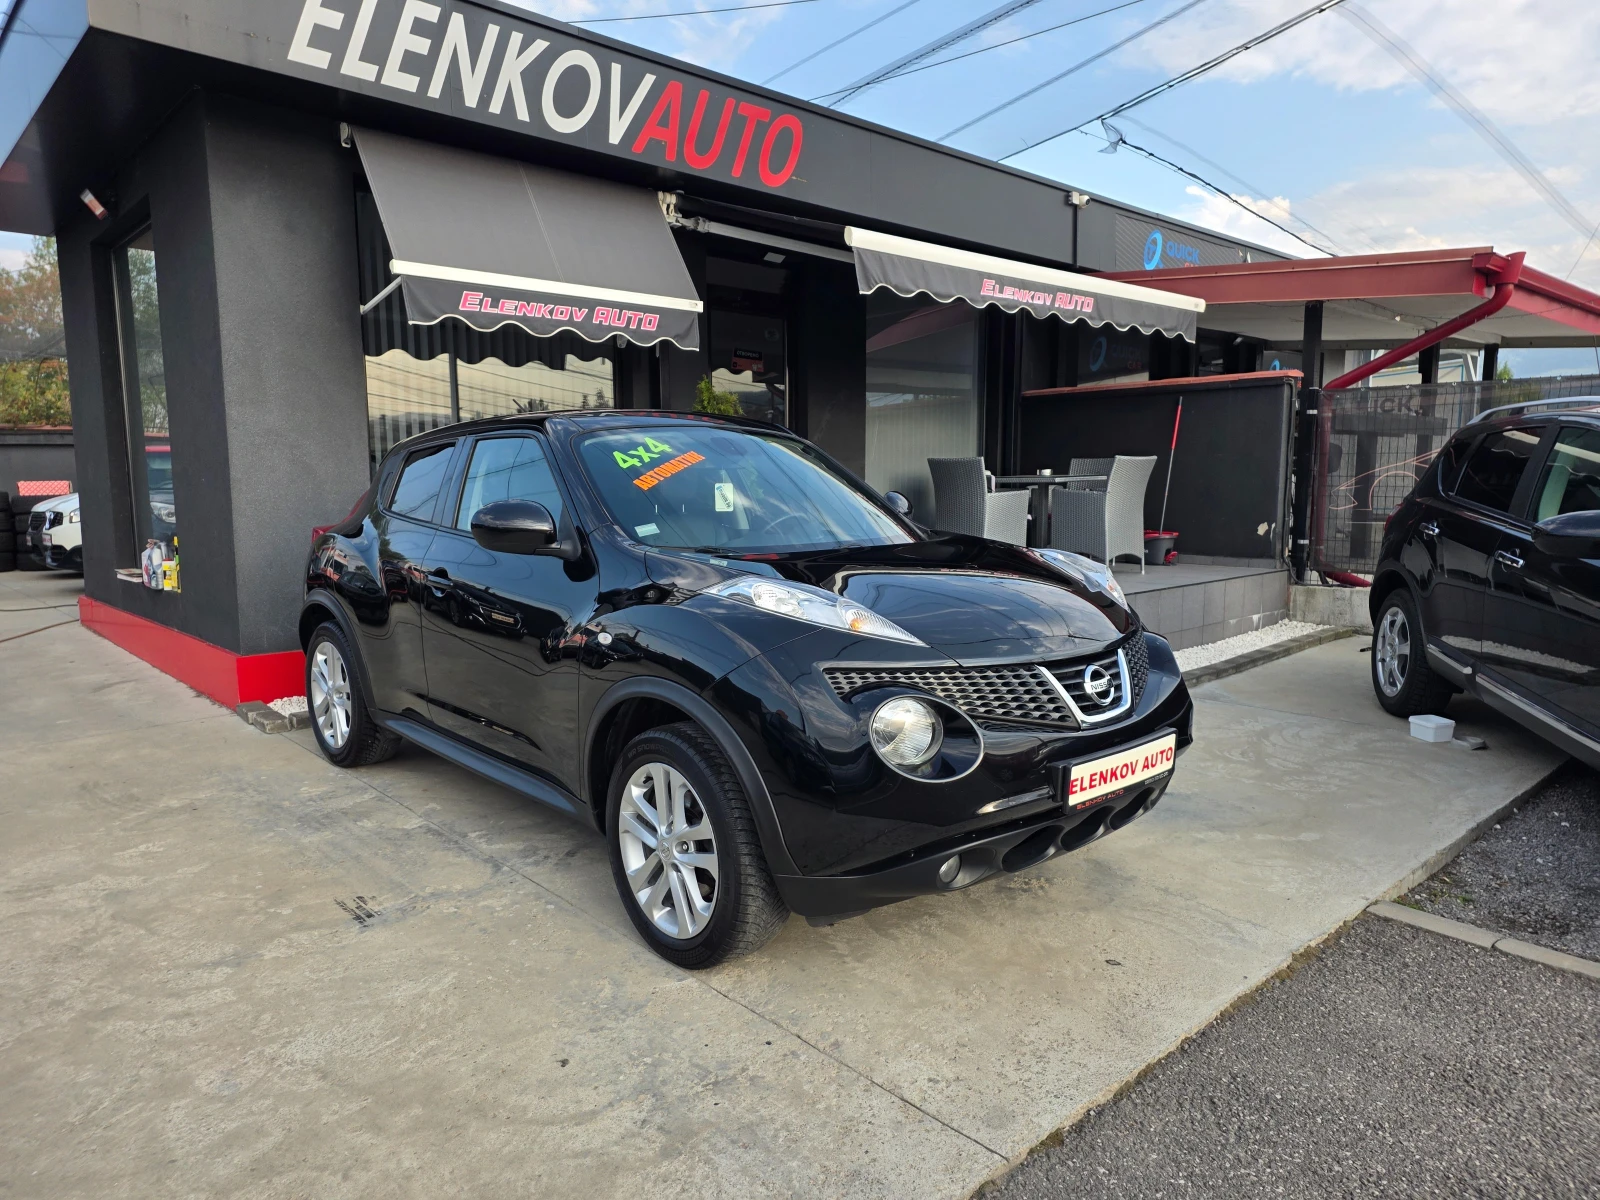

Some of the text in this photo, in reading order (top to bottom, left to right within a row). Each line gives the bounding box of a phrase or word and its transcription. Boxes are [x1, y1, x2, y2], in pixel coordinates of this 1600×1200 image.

[1166, 241, 1199, 263] QUICK
[459, 291, 659, 331] ELENKOV AUTO
[980, 278, 1094, 312] ELENKOV AUTO
[1068, 759, 1139, 795] ELENKOV
[1141, 746, 1173, 772] AUTO
